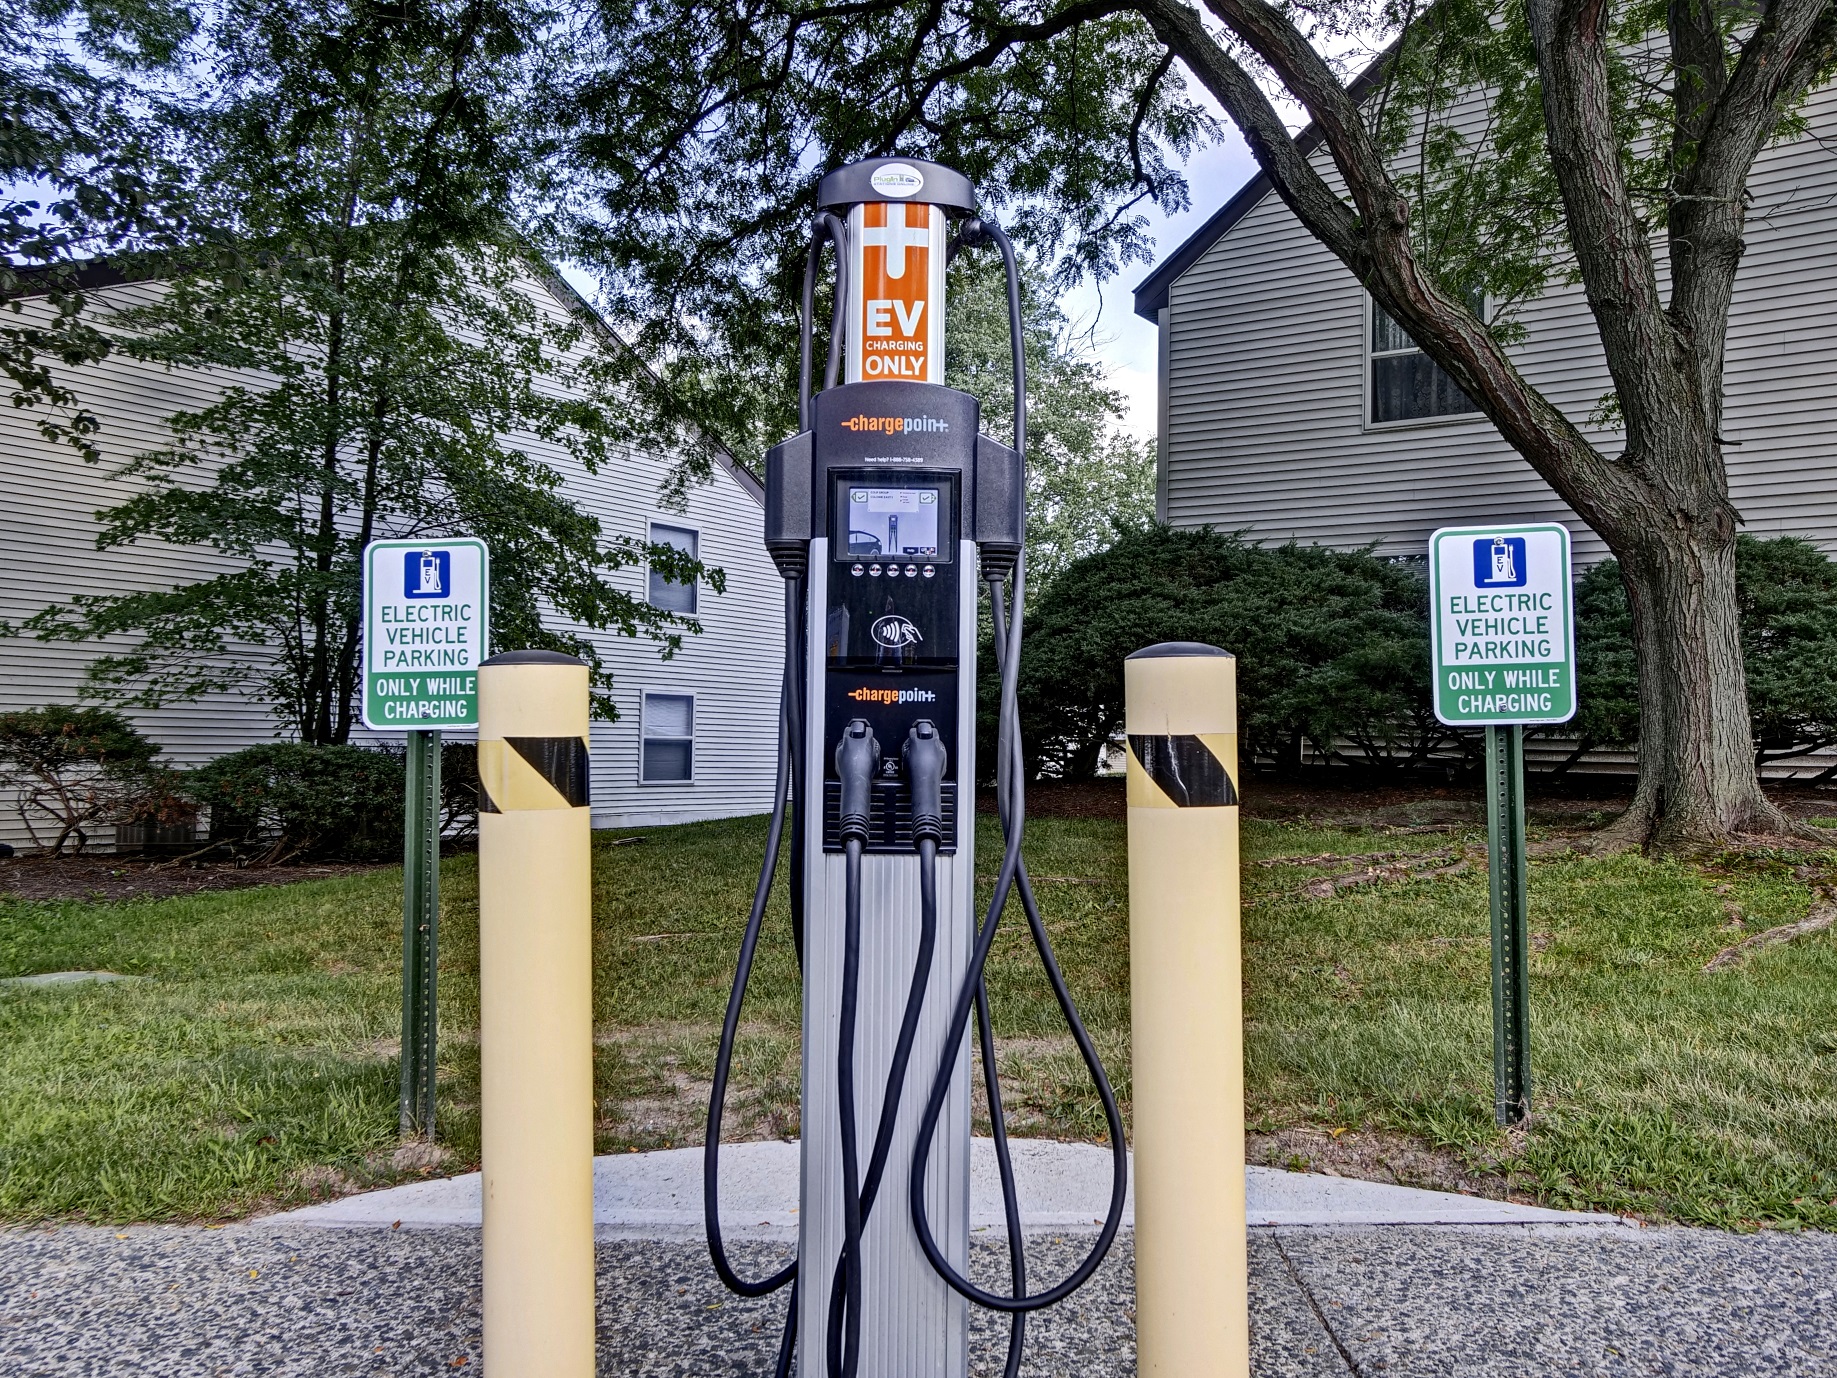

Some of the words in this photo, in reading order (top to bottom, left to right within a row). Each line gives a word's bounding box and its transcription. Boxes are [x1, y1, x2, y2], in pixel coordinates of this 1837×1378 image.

[866, 299, 925, 337] EV
[866, 340, 924, 351] CHARGING
[865, 355, 925, 376] ONLY
[1450, 592, 1552, 614] ELECTRIC
[381, 604, 471, 623] ELECTRIC
[386, 626, 467, 645] VEHICLE
[1456, 616, 1549, 637] VEHICLE
[384, 649, 469, 667] PARKING
[1455, 639, 1551, 660] PARKING
[376, 678, 421, 696] ONLY
[426, 677, 475, 696] WHILE
[1448, 671, 1496, 690] ONLY
[1503, 669, 1560, 689] WHILE
[384, 700, 467, 719] CHARGING
[1458, 693, 1552, 713] CHARGING
